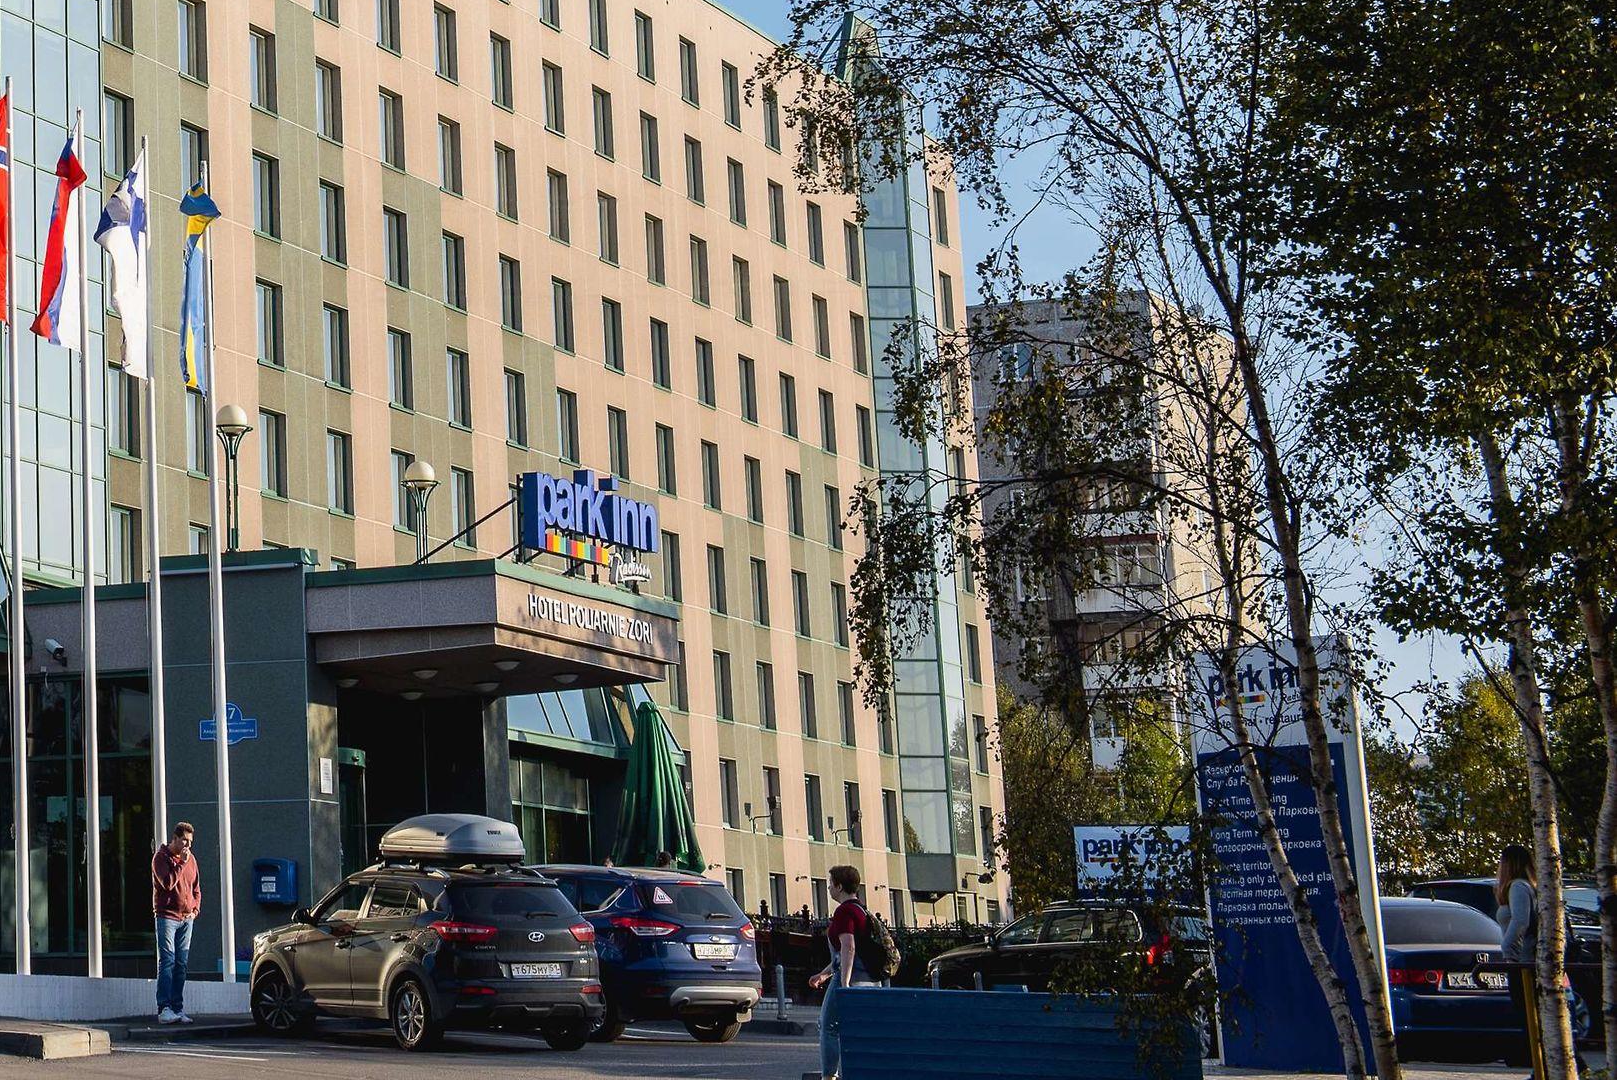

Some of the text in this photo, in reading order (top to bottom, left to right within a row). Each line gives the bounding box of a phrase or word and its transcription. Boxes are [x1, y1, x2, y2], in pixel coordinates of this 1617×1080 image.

[522, 470, 659, 553] park inn
[528, 593, 653, 645] HOTEL POLIARNIE ZORI
[1232, 828, 1253, 839] Term
[1242, 860, 1272, 871] territor
